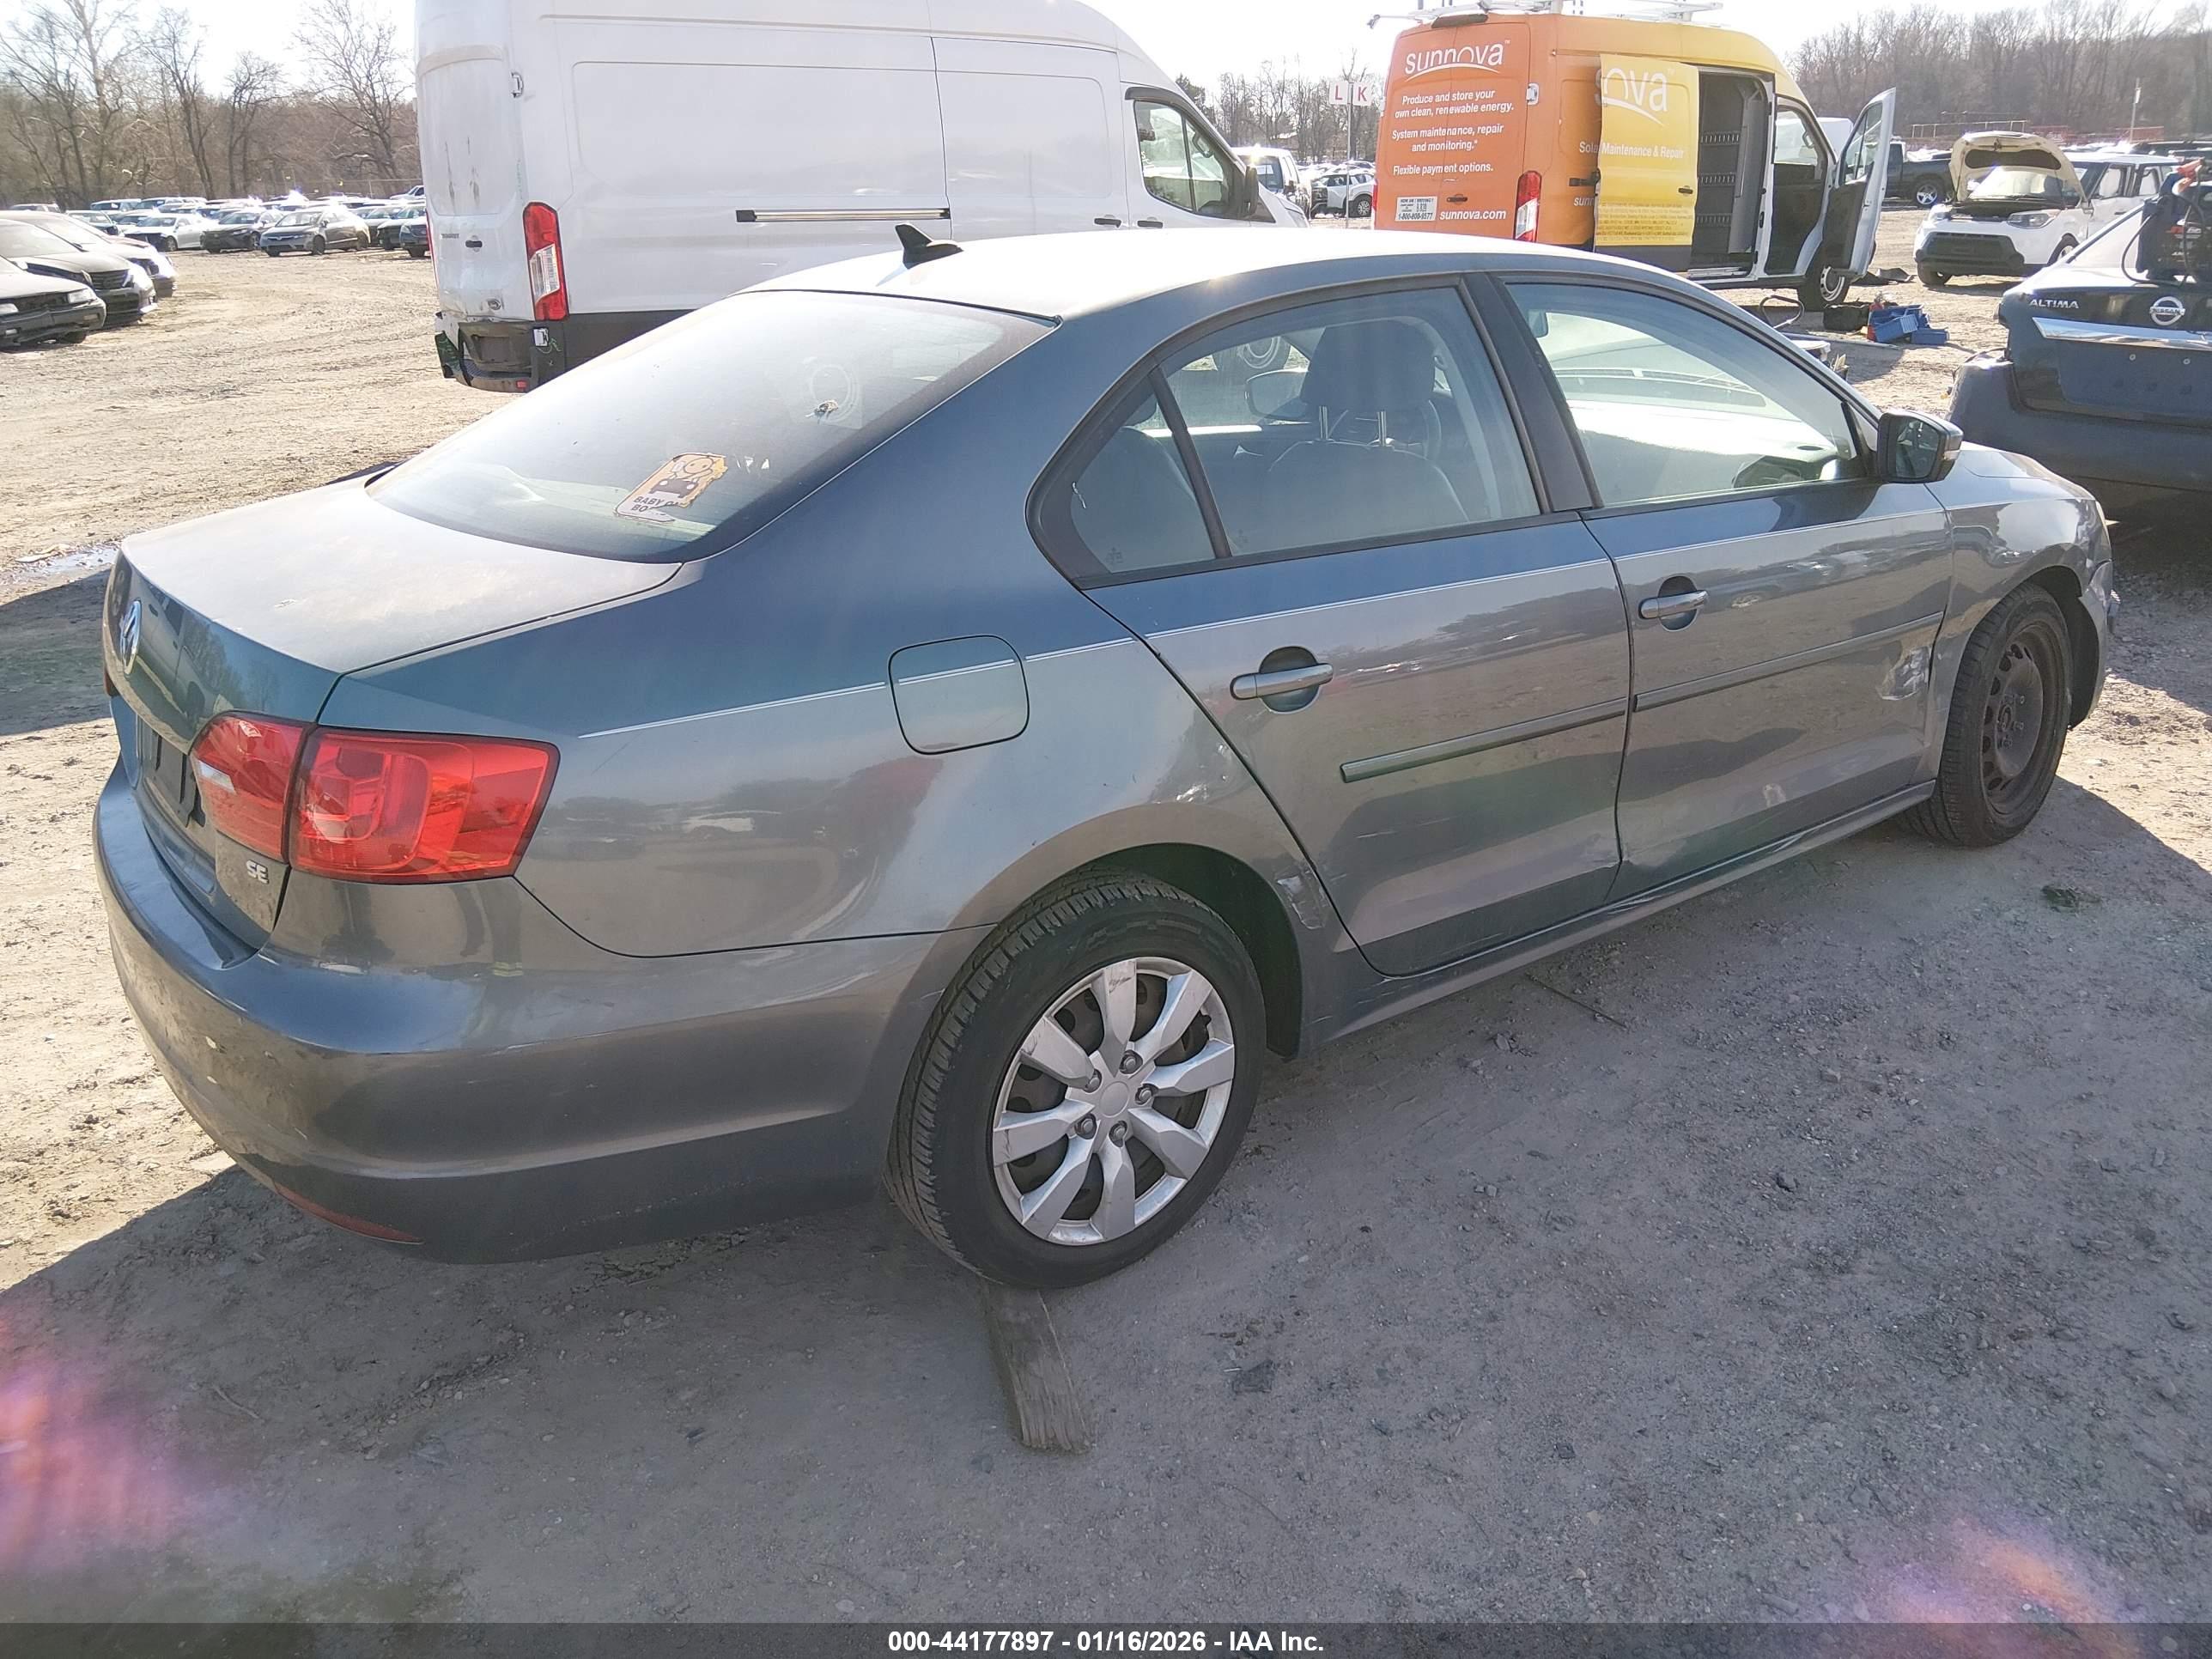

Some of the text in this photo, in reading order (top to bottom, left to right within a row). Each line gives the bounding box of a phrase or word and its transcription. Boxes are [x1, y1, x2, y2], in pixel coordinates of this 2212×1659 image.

[1405, 43, 1504, 74] sunnova
[1334, 85, 1343, 100] L
[1358, 86, 1368, 102] K
[1401, 89, 1496, 105] Produce and store your
[1395, 101, 1514, 118] own clean, renewable energy.
[1392, 123, 1504, 141] System maintenance, repair
[1411, 142, 1426, 152] and
[1601, 142, 1651, 157] Maintenance
[1653, 145, 1660, 156] &
[1661, 146, 1684, 159] Repair
[1393, 162, 1493, 176] Flexible payment options.
[1439, 210, 1506, 220] sunnova.com
[2029, 298, 2080, 309] ALTIMA
[633, 495, 665, 506] BABY
[245, 860, 270, 884] SE
